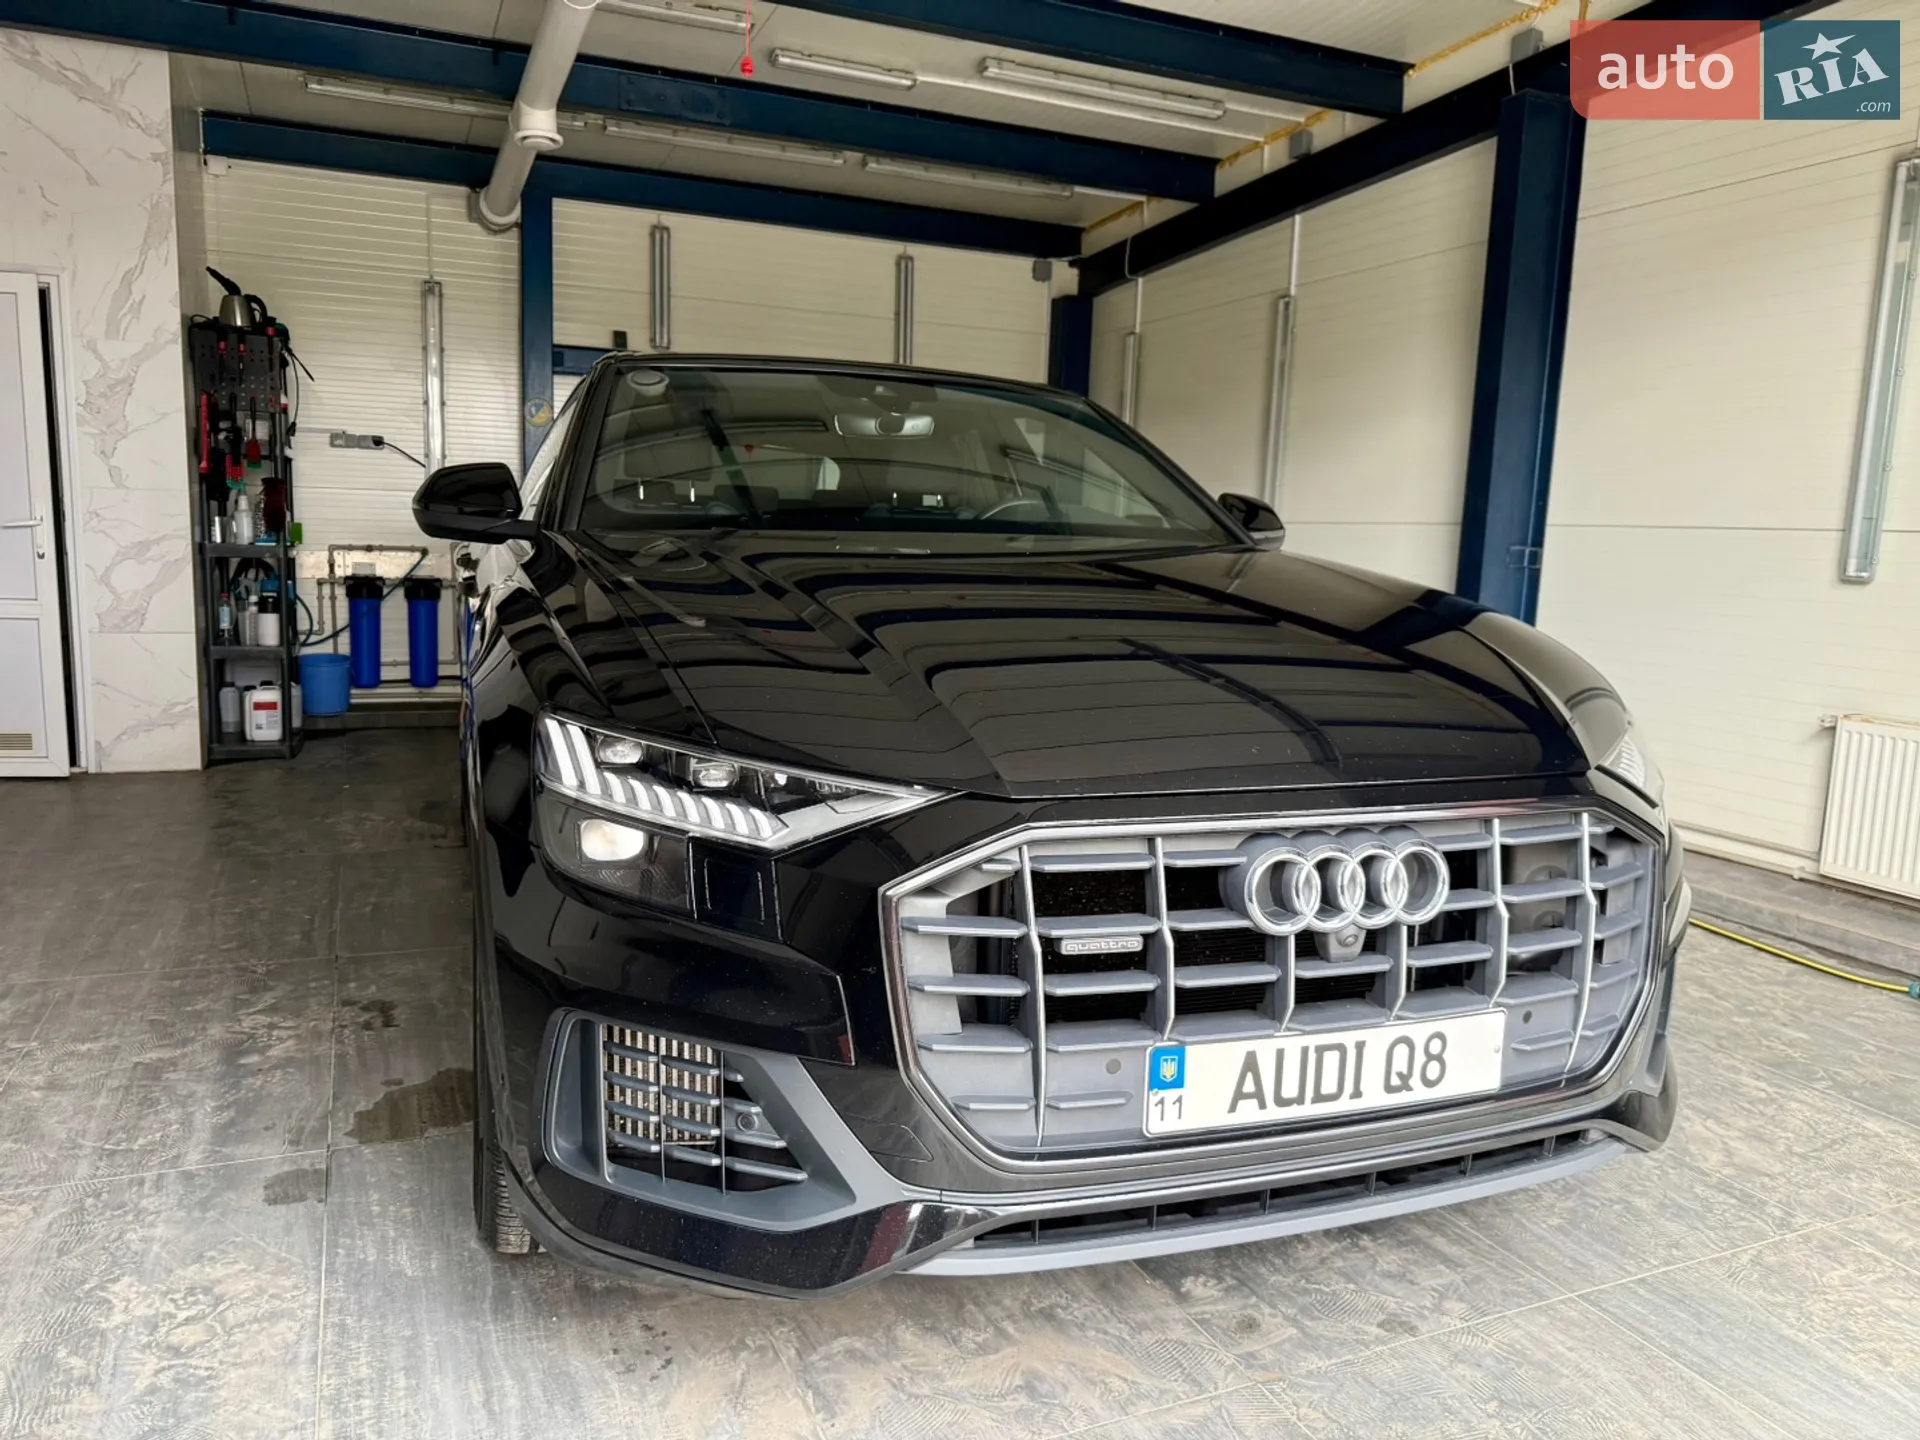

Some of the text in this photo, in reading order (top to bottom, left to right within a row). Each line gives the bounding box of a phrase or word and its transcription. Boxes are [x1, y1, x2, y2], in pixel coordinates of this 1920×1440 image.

[1066, 940, 1139, 954] quattro
[1227, 1031, 1447, 1113] AUDI Q8
[1153, 1094, 1184, 1122] 11
